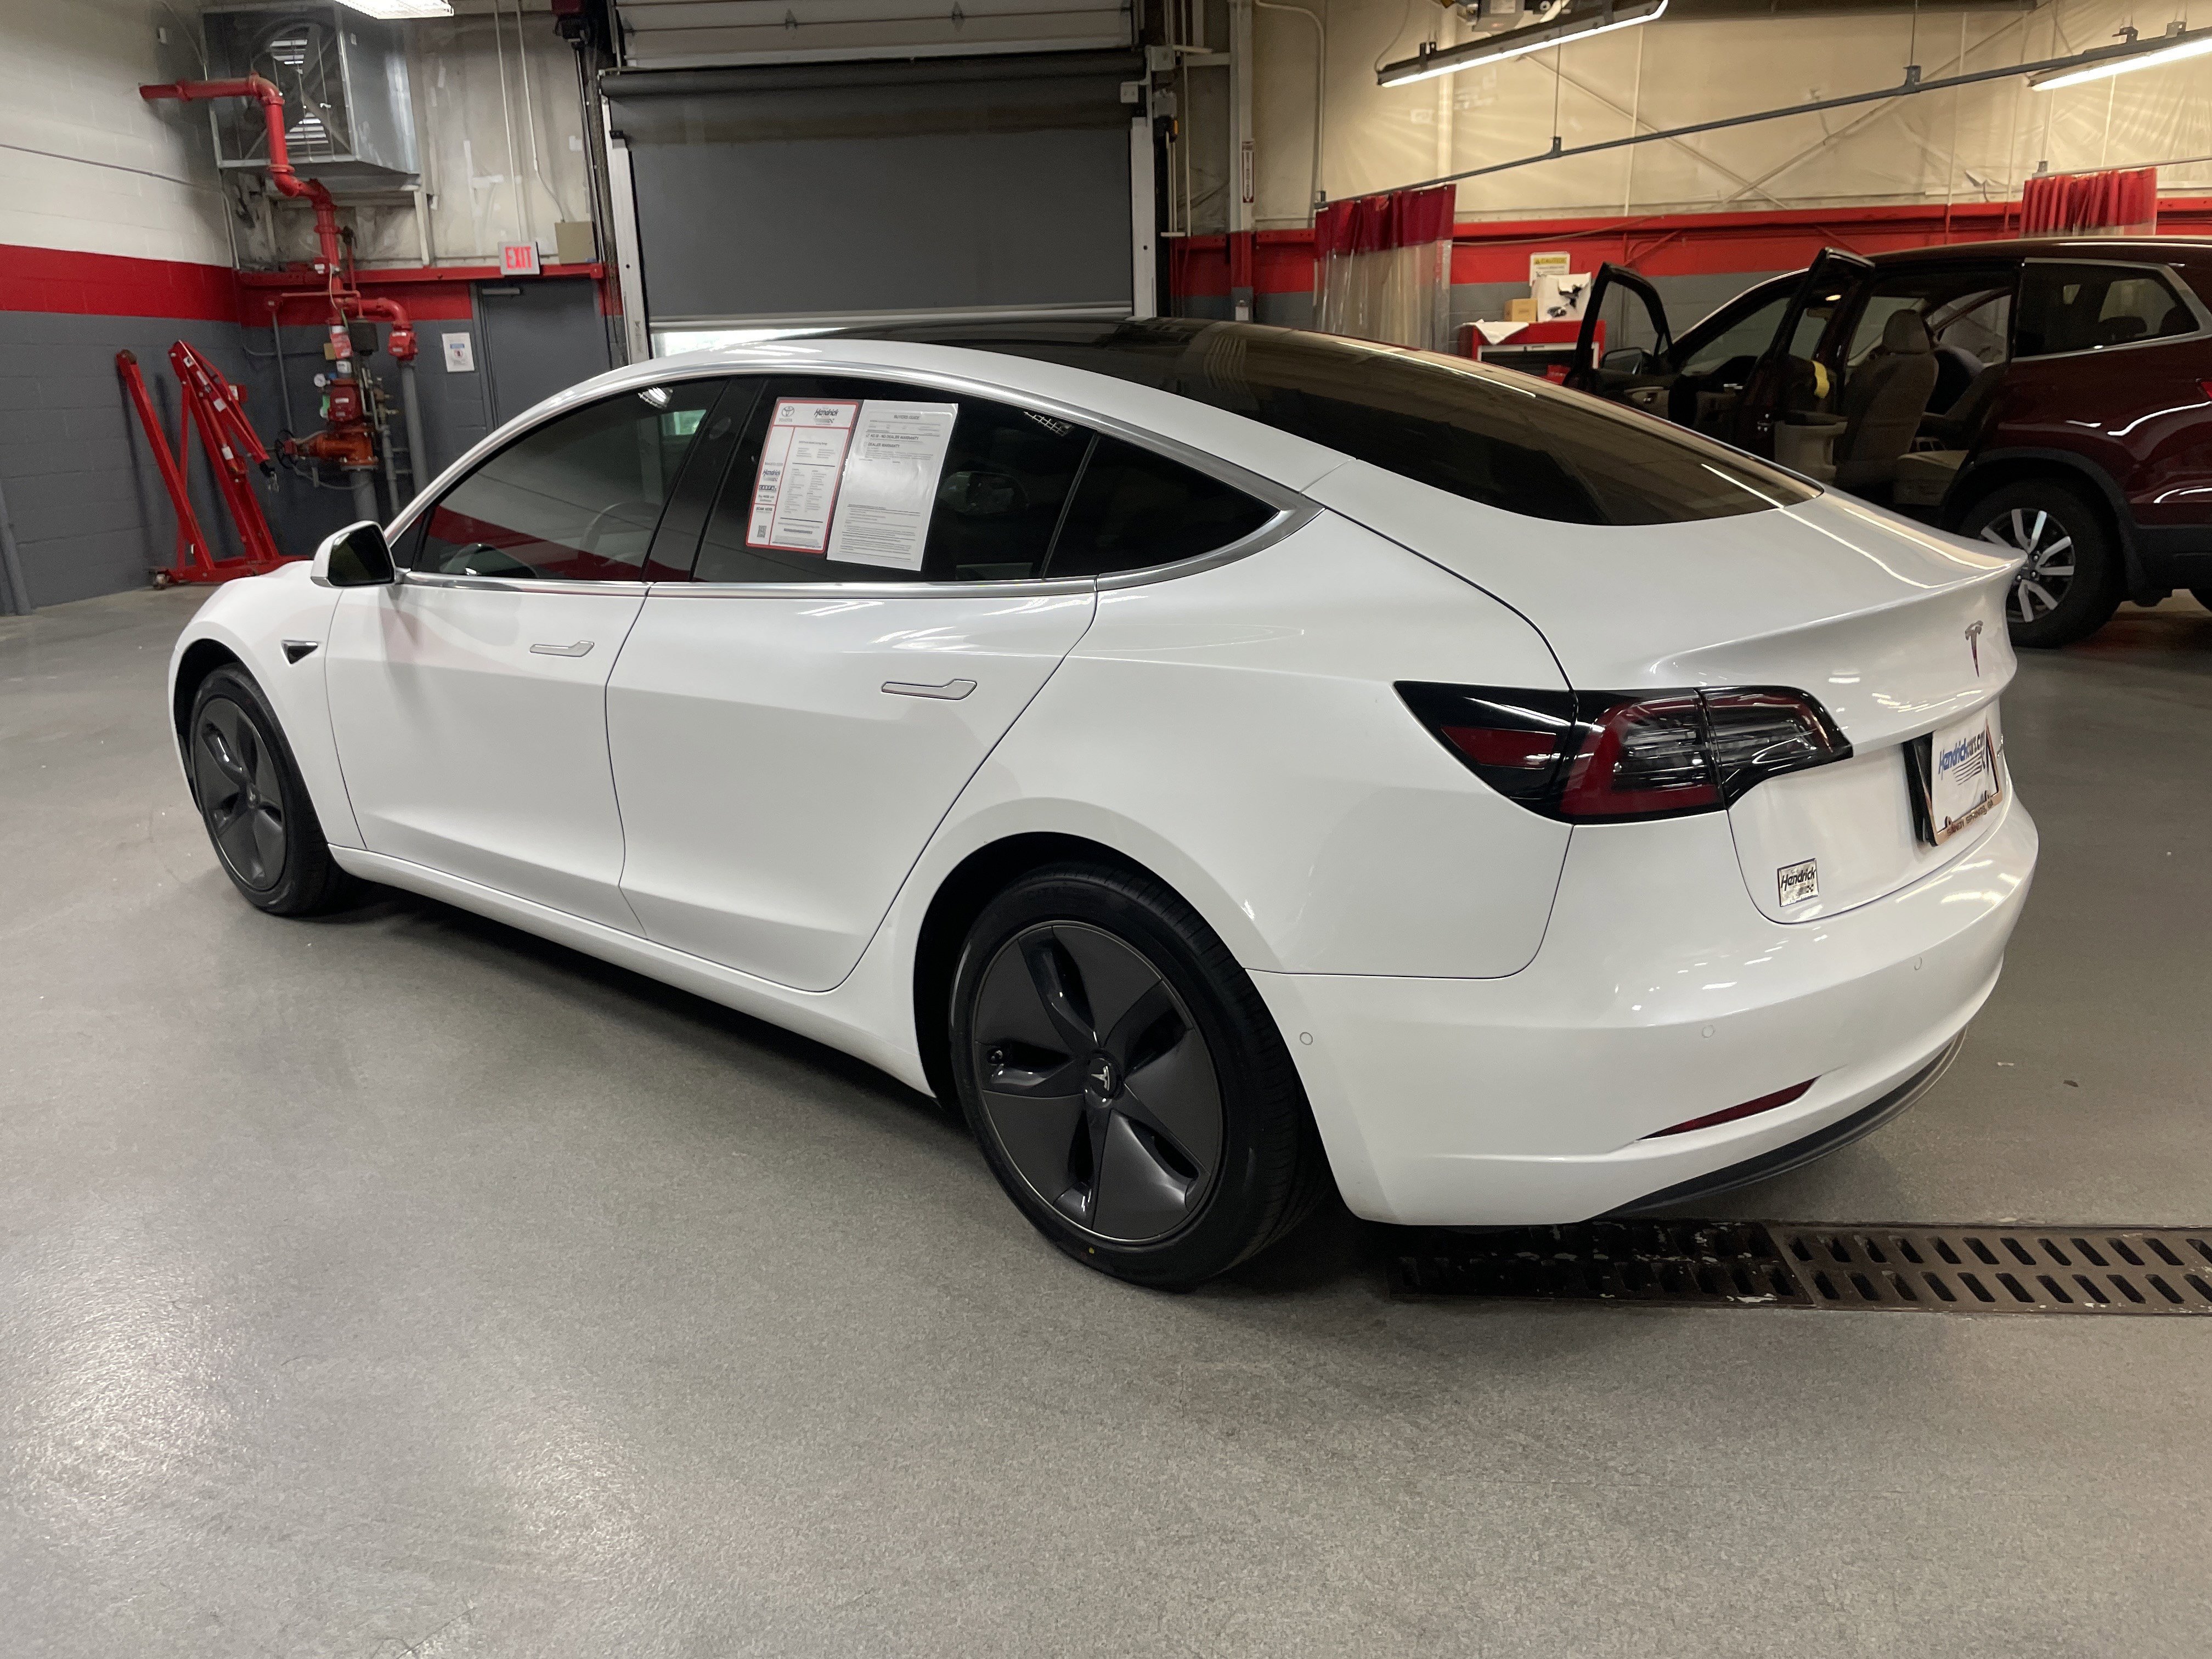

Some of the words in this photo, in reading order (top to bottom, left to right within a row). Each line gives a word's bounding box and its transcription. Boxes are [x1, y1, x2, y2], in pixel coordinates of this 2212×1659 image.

[505, 246, 532, 269] EXIT
[814, 408, 839, 417] Hendrick
[1781, 867, 1816, 891] Hendrick
